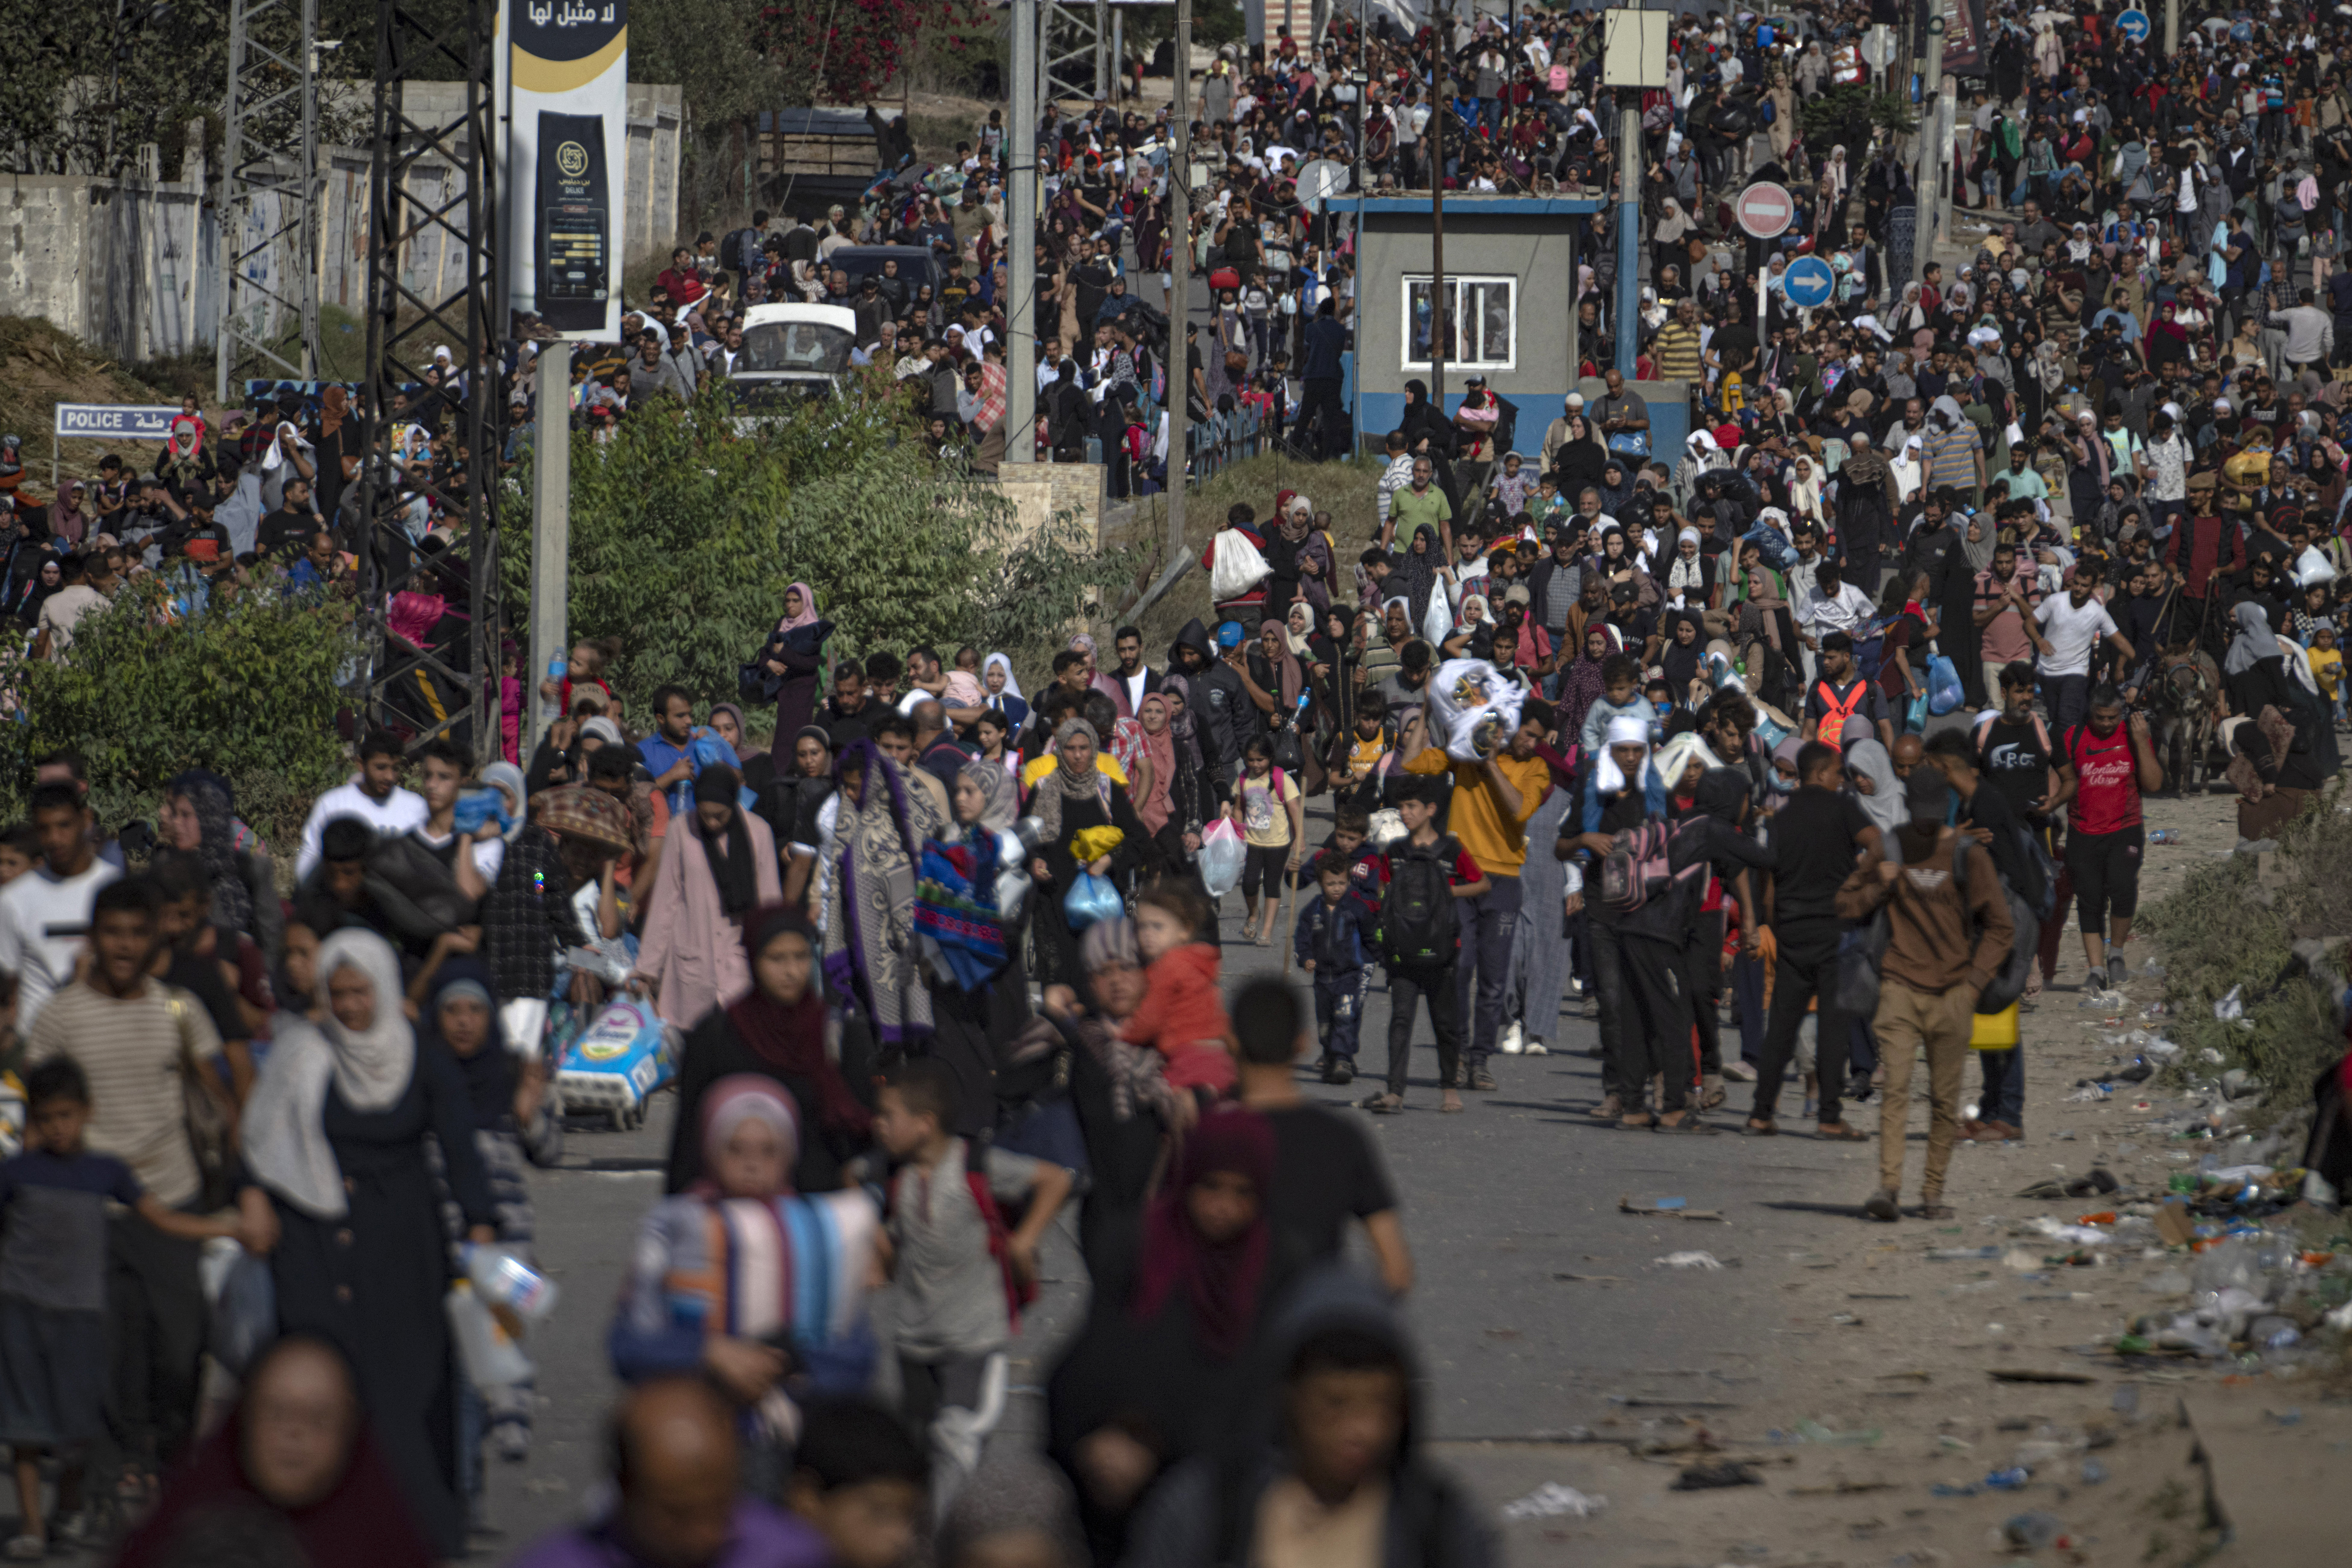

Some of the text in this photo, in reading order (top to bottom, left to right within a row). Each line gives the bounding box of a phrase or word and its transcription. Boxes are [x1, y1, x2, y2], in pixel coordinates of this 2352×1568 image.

[529, 0, 615, 27] لا مثيل لها
[67, 412, 123, 427] POLICE
